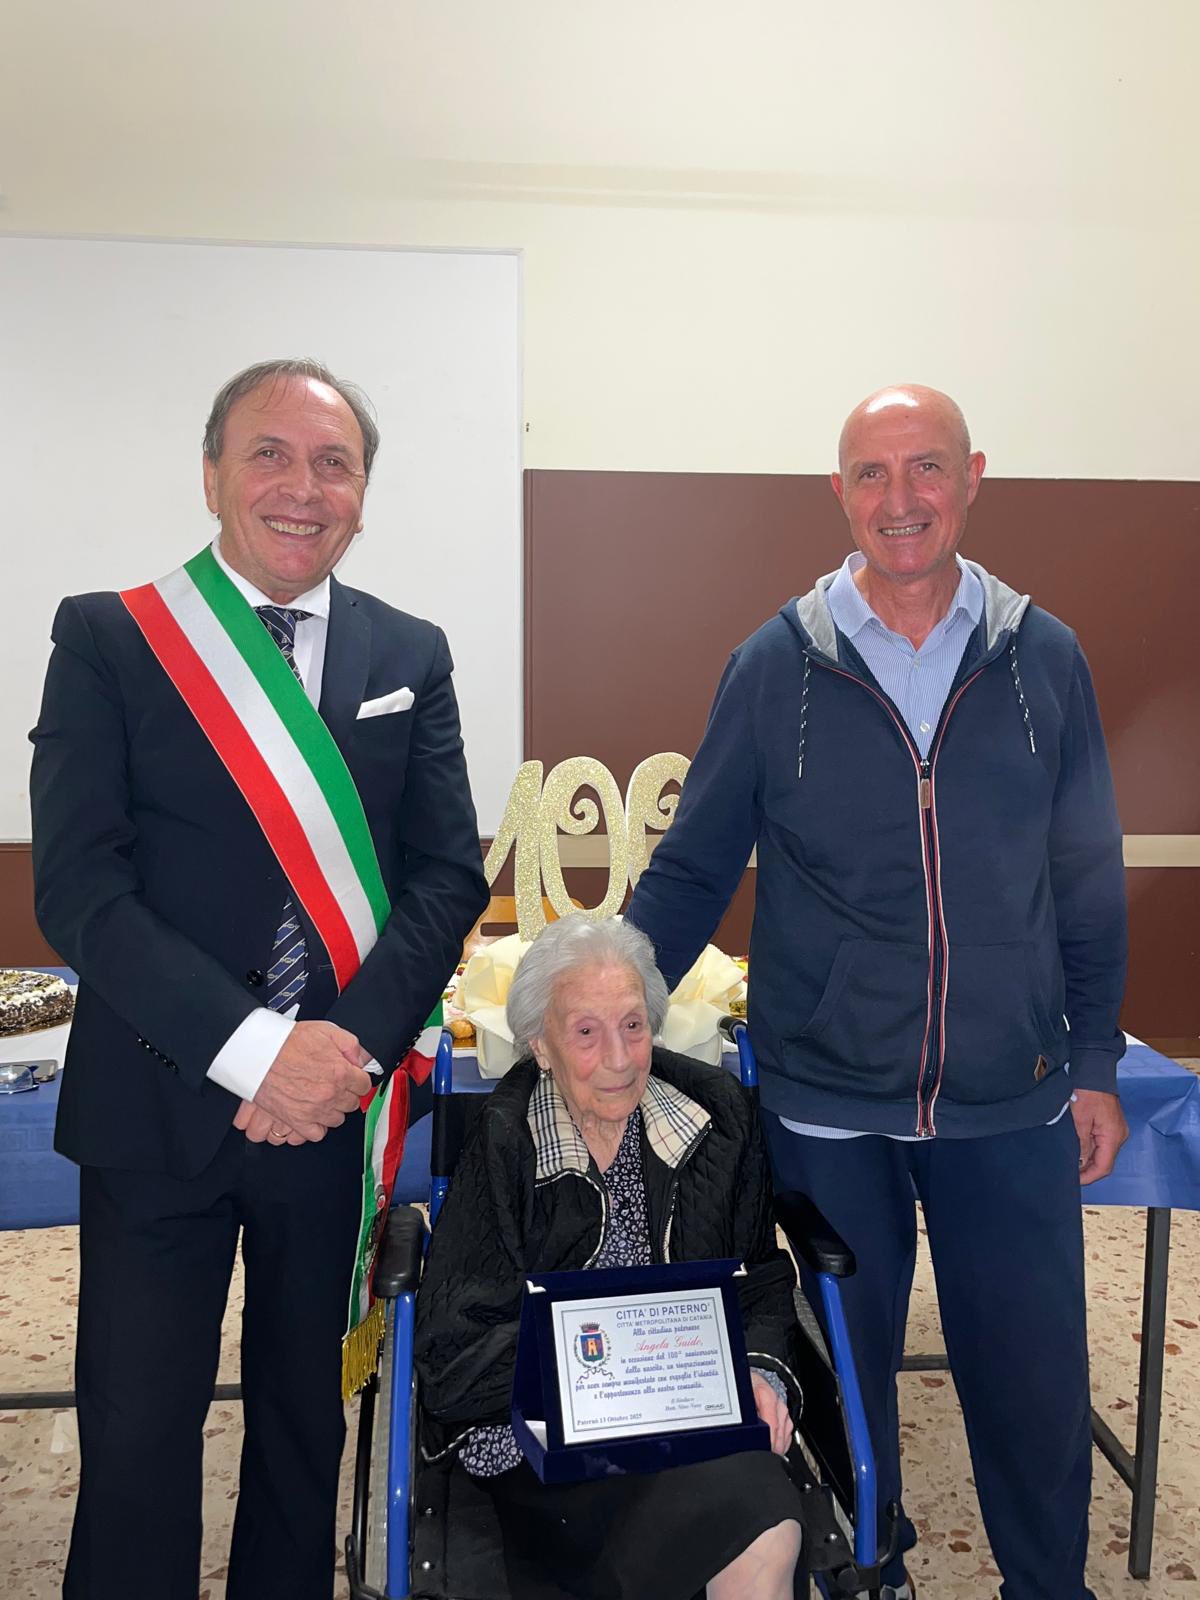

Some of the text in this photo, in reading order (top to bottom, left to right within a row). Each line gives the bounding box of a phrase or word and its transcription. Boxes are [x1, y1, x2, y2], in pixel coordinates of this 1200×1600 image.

[616, 1303, 710, 1320] CITTA' DI PATERNO'
[635, 1318, 681, 1327] METROPOLITANA
[634, 1339, 670, 1353] Angela
